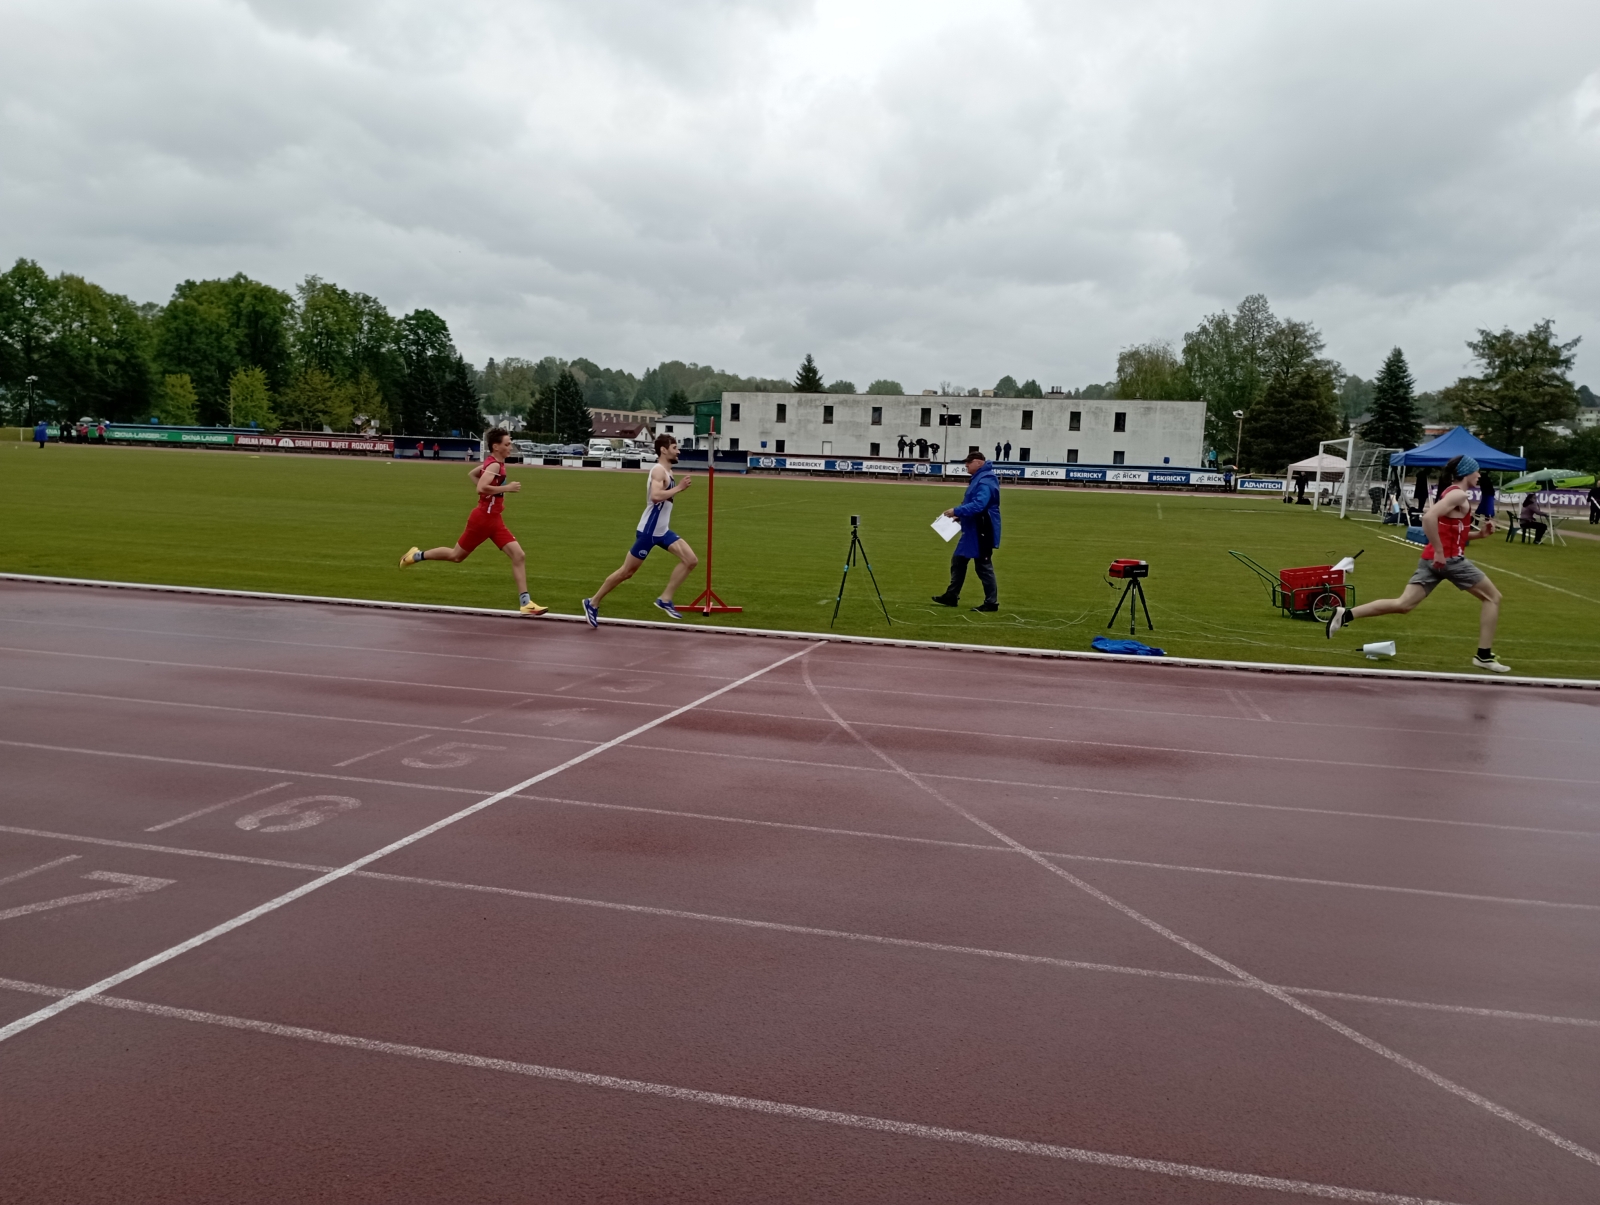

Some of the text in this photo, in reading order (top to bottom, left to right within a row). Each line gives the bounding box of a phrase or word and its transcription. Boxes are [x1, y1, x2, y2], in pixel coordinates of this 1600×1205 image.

[260, 438, 277, 446] PERLA
[295, 439, 312, 447] DENNÍ
[313, 440, 329, 448] MENU
[331, 441, 349, 449] BUFET
[374, 442, 390, 451] JÍDEL
[1243, 481, 1281, 490] ADVANTECH
[401, 742, 506, 770] 5
[235, 794, 363, 833] 6
[0, 869, 178, 920] 7
